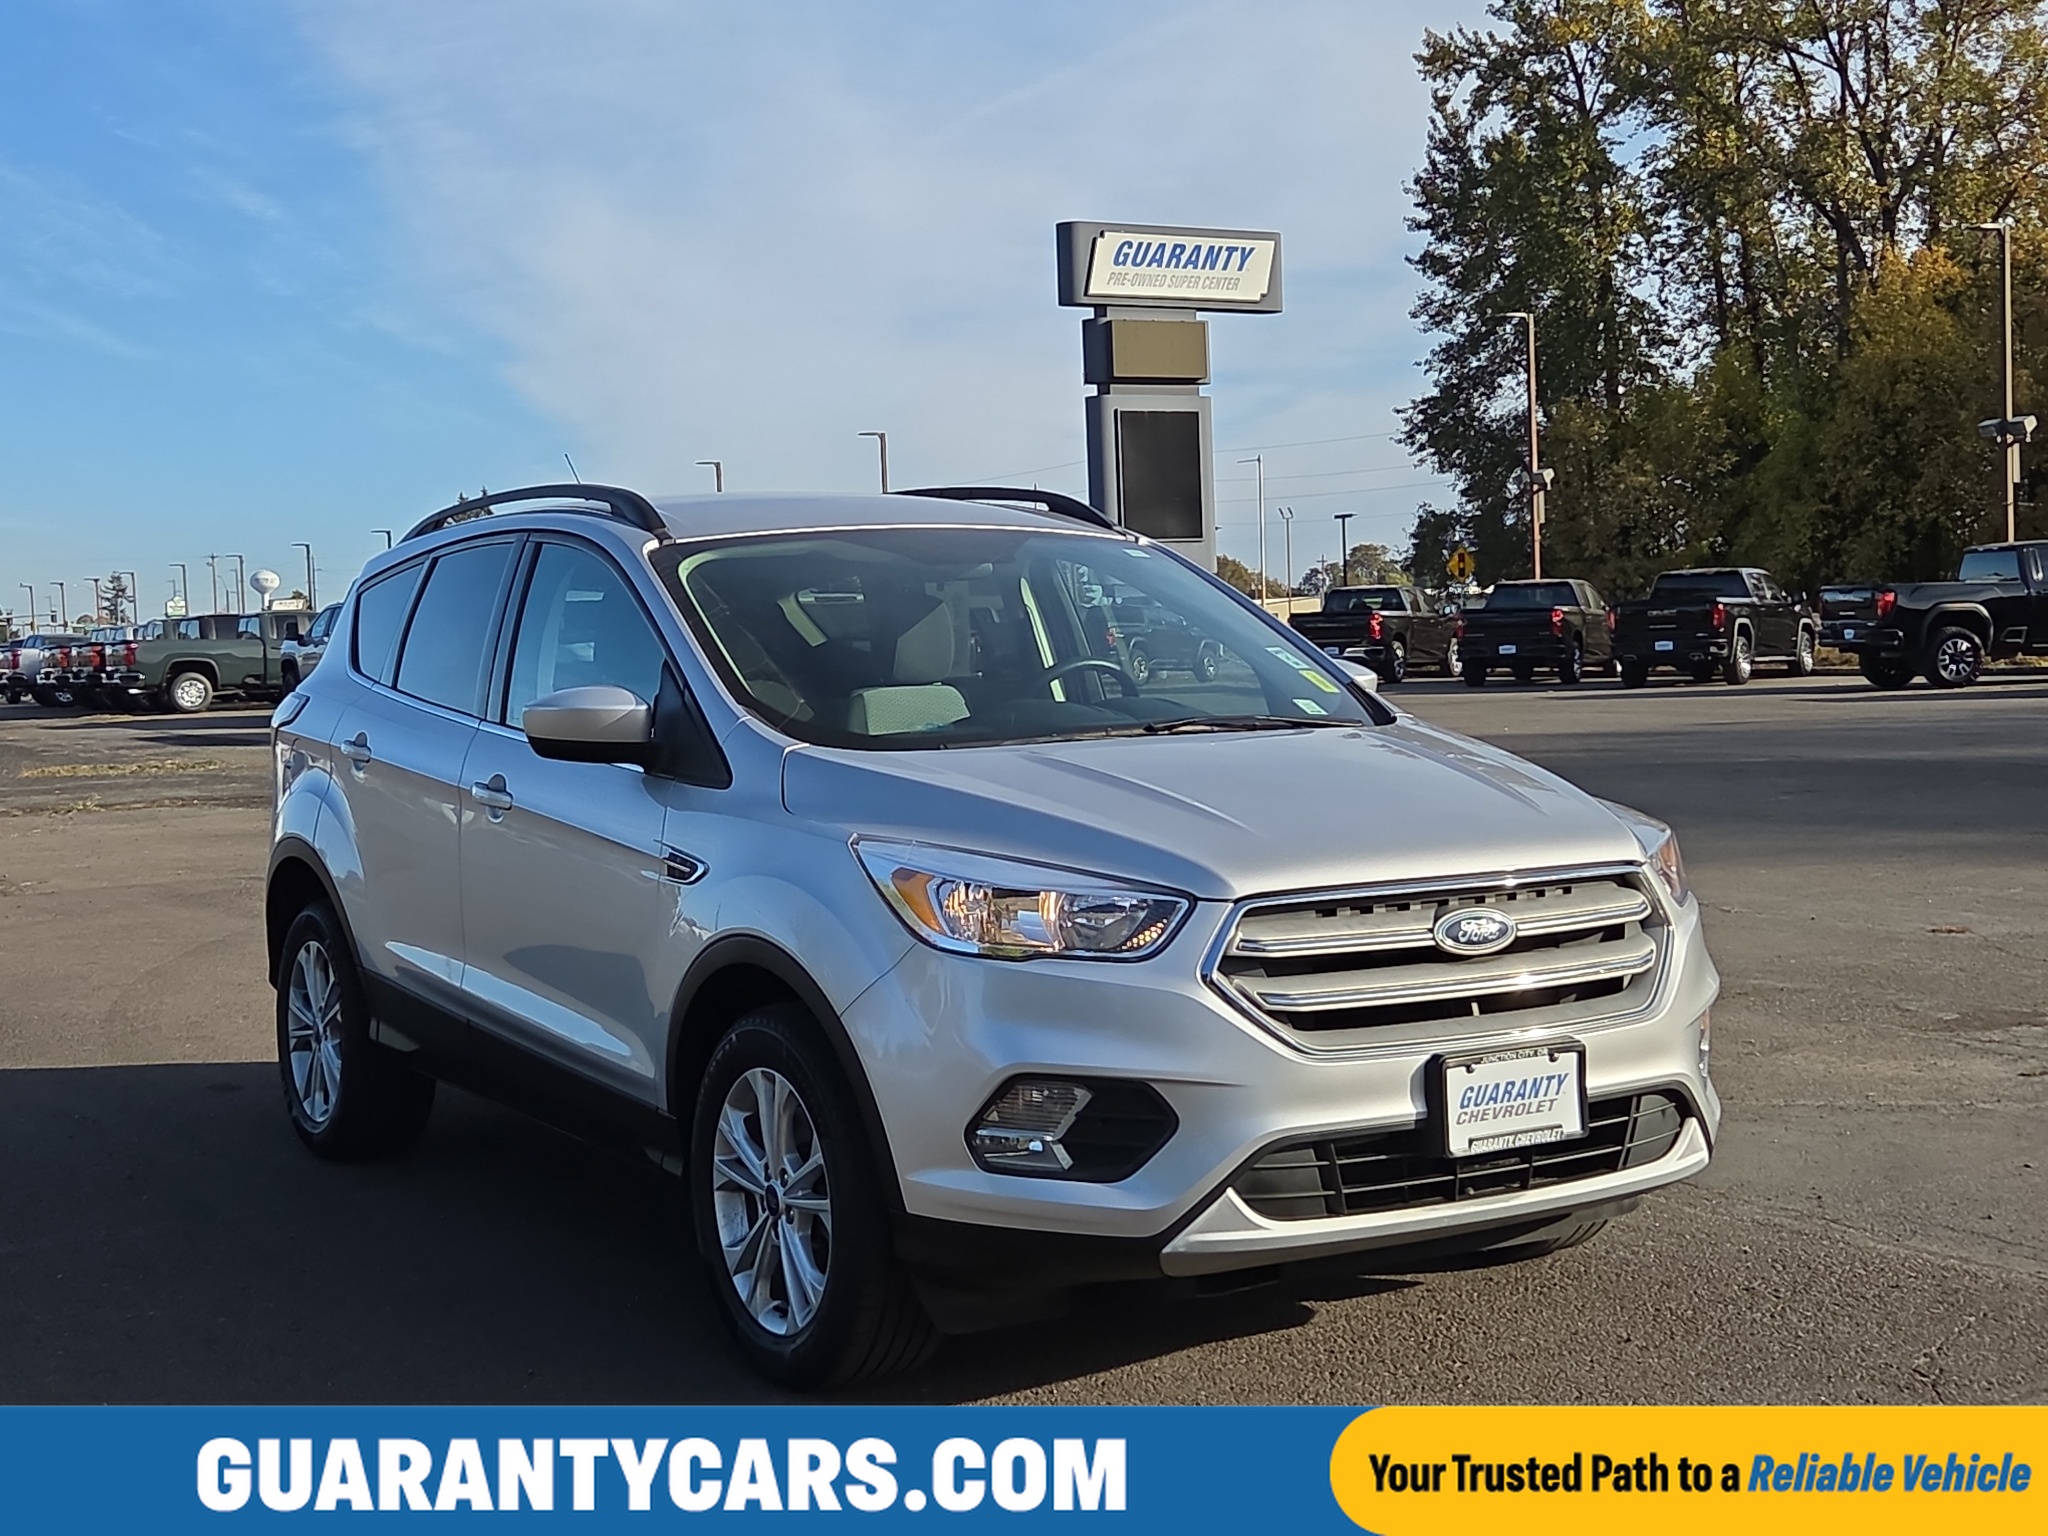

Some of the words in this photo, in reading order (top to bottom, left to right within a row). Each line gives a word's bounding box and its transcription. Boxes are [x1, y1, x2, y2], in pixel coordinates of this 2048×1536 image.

[1113, 241, 1256, 272] GUARANTY
[1107, 272, 1167, 288] PRE-OWNED
[1167, 275, 1201, 290] SUPER
[1201, 276, 1240, 291] CENTER
[1458, 918, 1500, 943] Ford
[1459, 1073, 1569, 1110] GUARANTY
[1456, 1098, 1558, 1125] CHEVROLET
[1471, 1134, 1515, 1154] GUARANTY
[1515, 1127, 1564, 1147] CHEVROLET
